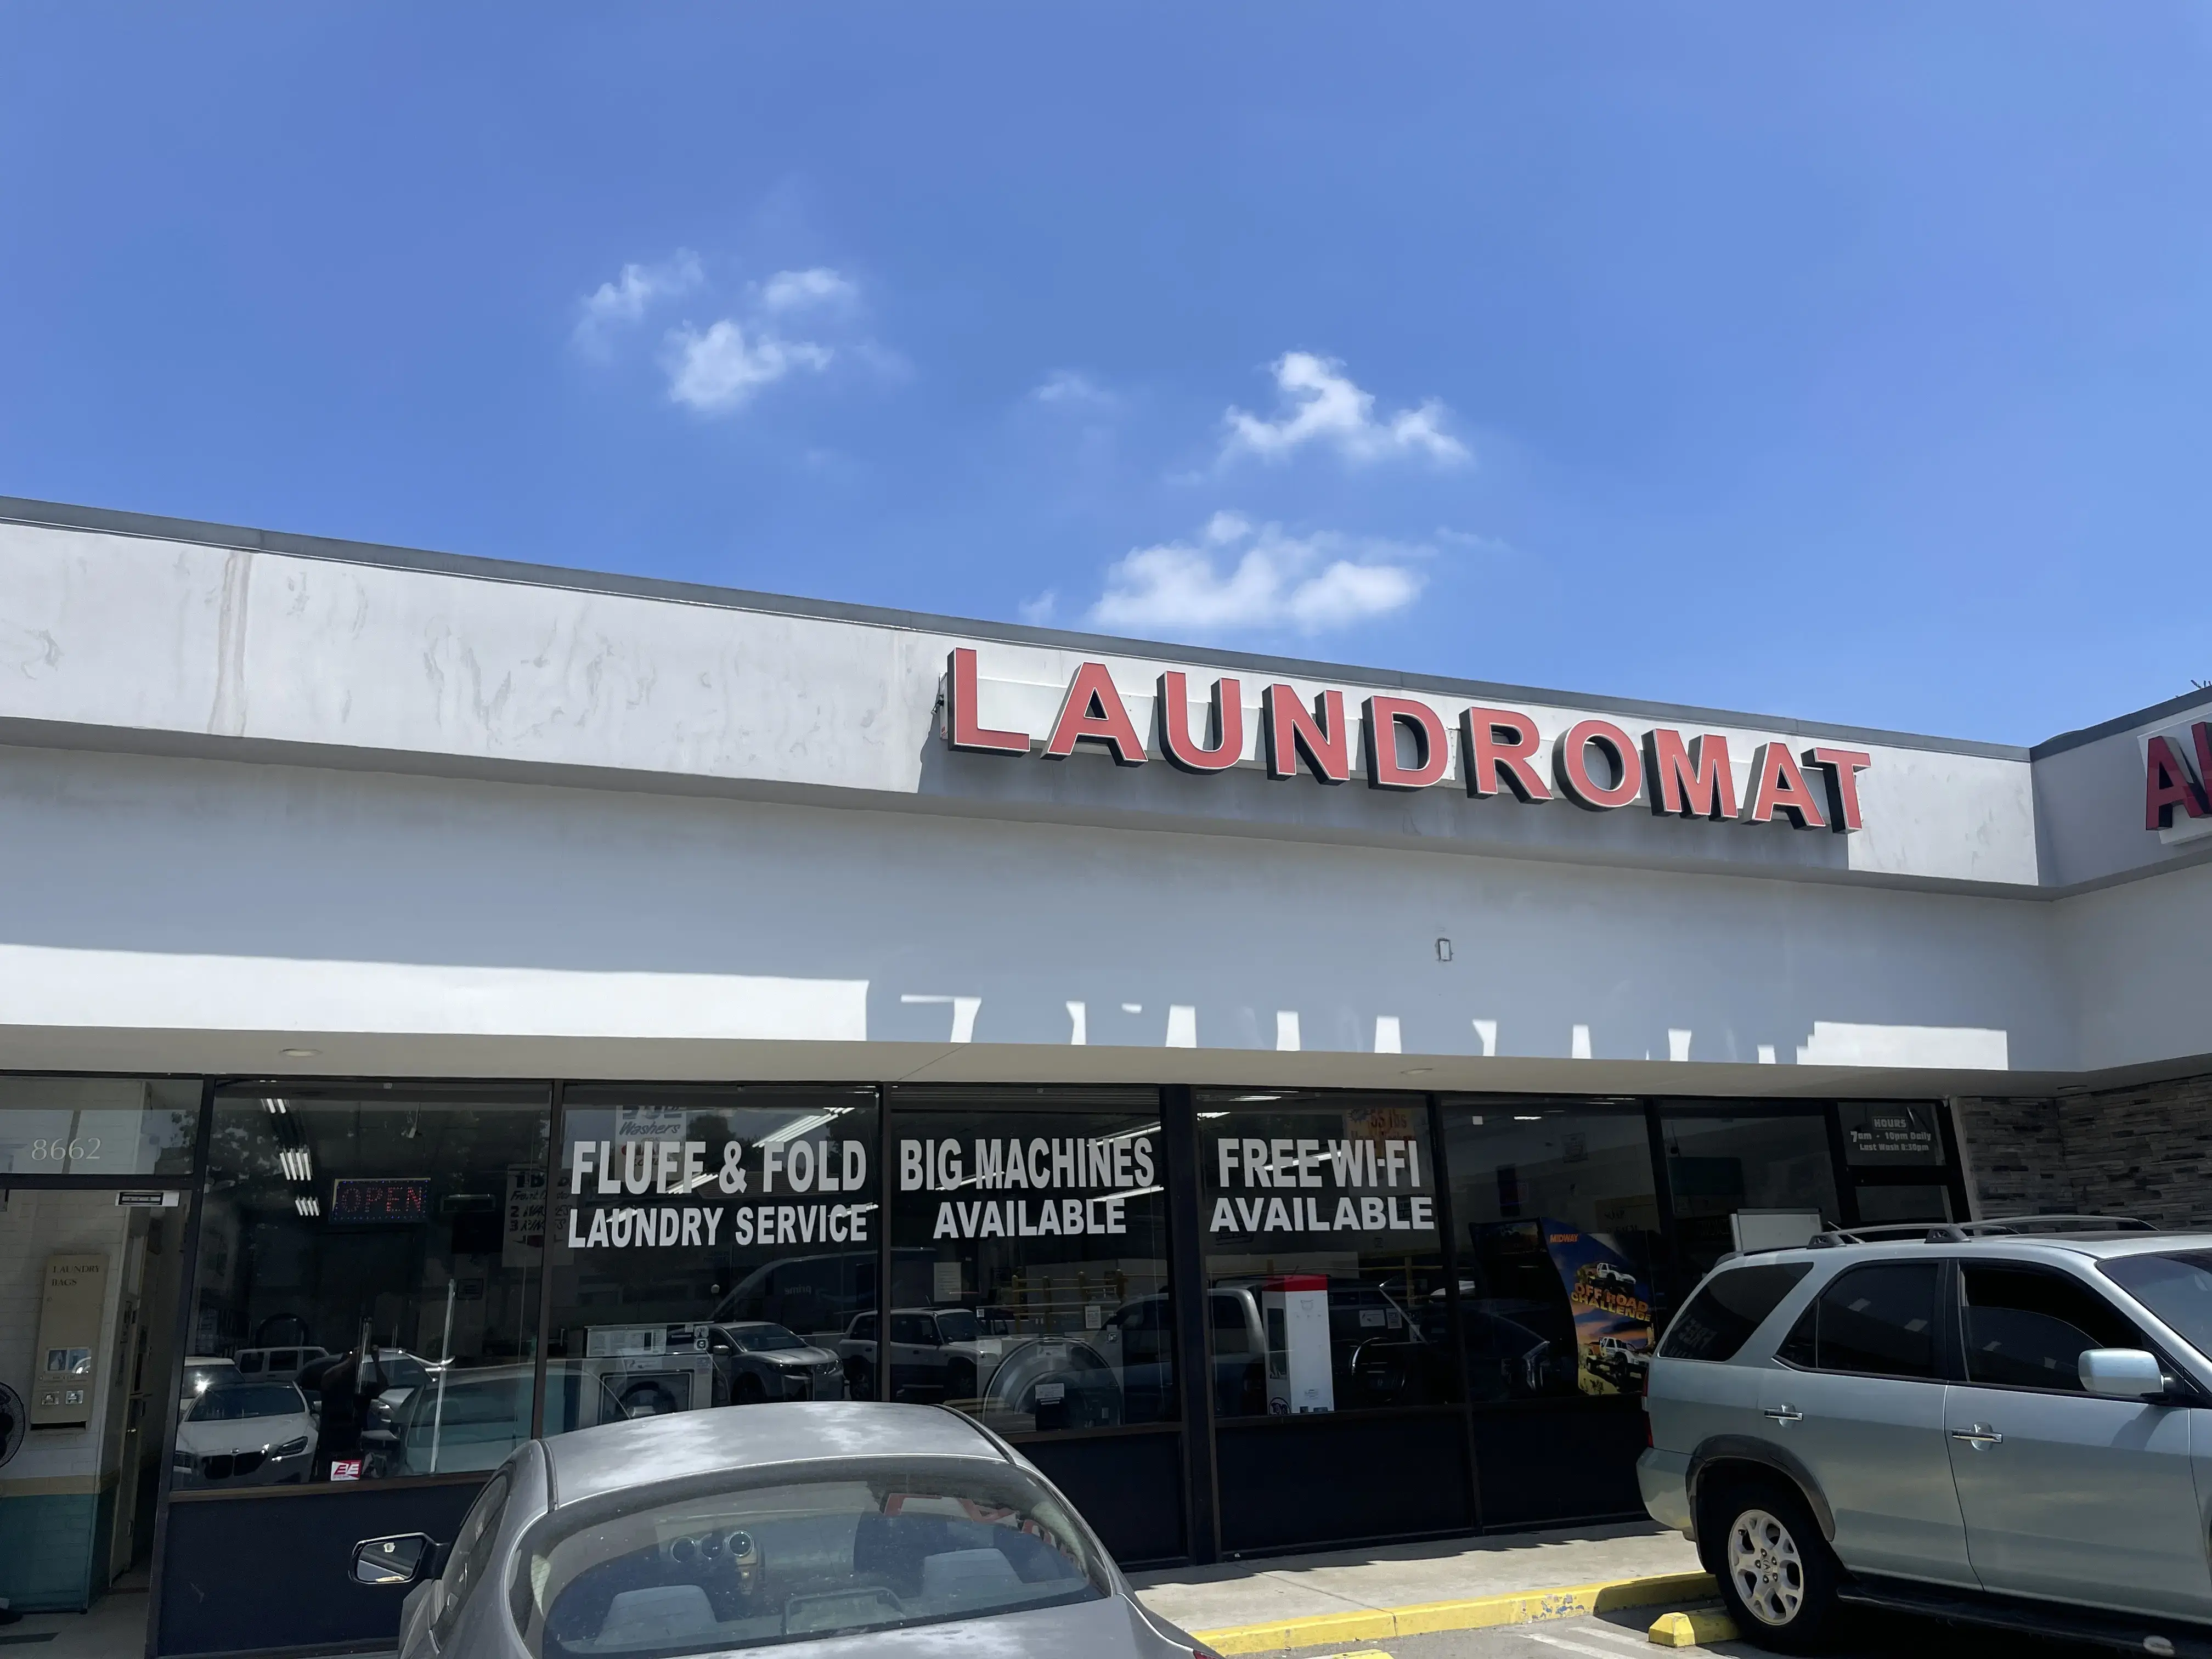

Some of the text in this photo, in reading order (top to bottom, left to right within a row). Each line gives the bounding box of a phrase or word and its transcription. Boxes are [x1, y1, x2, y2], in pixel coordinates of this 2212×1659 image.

[947, 647, 1871, 834] LAUNDROMAT
[619, 1121, 681, 1136] Washers
[1850, 1131, 1872, 1143] 7am
[1884, 1131, 1909, 1141] 10pm
[1910, 1131, 1932, 1141] Daily
[1874, 1118, 1907, 1128] HOURS
[30, 1138, 102, 1161] 8662
[1859, 1143, 1877, 1152] Last
[1878, 1143, 1899, 1152] Wash
[571, 1141, 867, 1195] FLUFF & FOLD
[900, 1137, 1154, 1190] BIG MACHINES
[1217, 1138, 1420, 1188] FREE WI-FI
[340, 1187, 422, 1214] OPEN
[1209, 1197, 1435, 1232] AVAILABLE
[568, 1204, 867, 1248] LAUNDRY SERVICE
[933, 1199, 1126, 1239] AVAILABLE
[1550, 1234, 1578, 1243] MIDWAY
[52, 1265, 100, 1273] LAUNDRY
[1571, 1291, 1651, 1322] CHALLENGE
[1575, 1283, 1649, 1312] OFF ROAD
